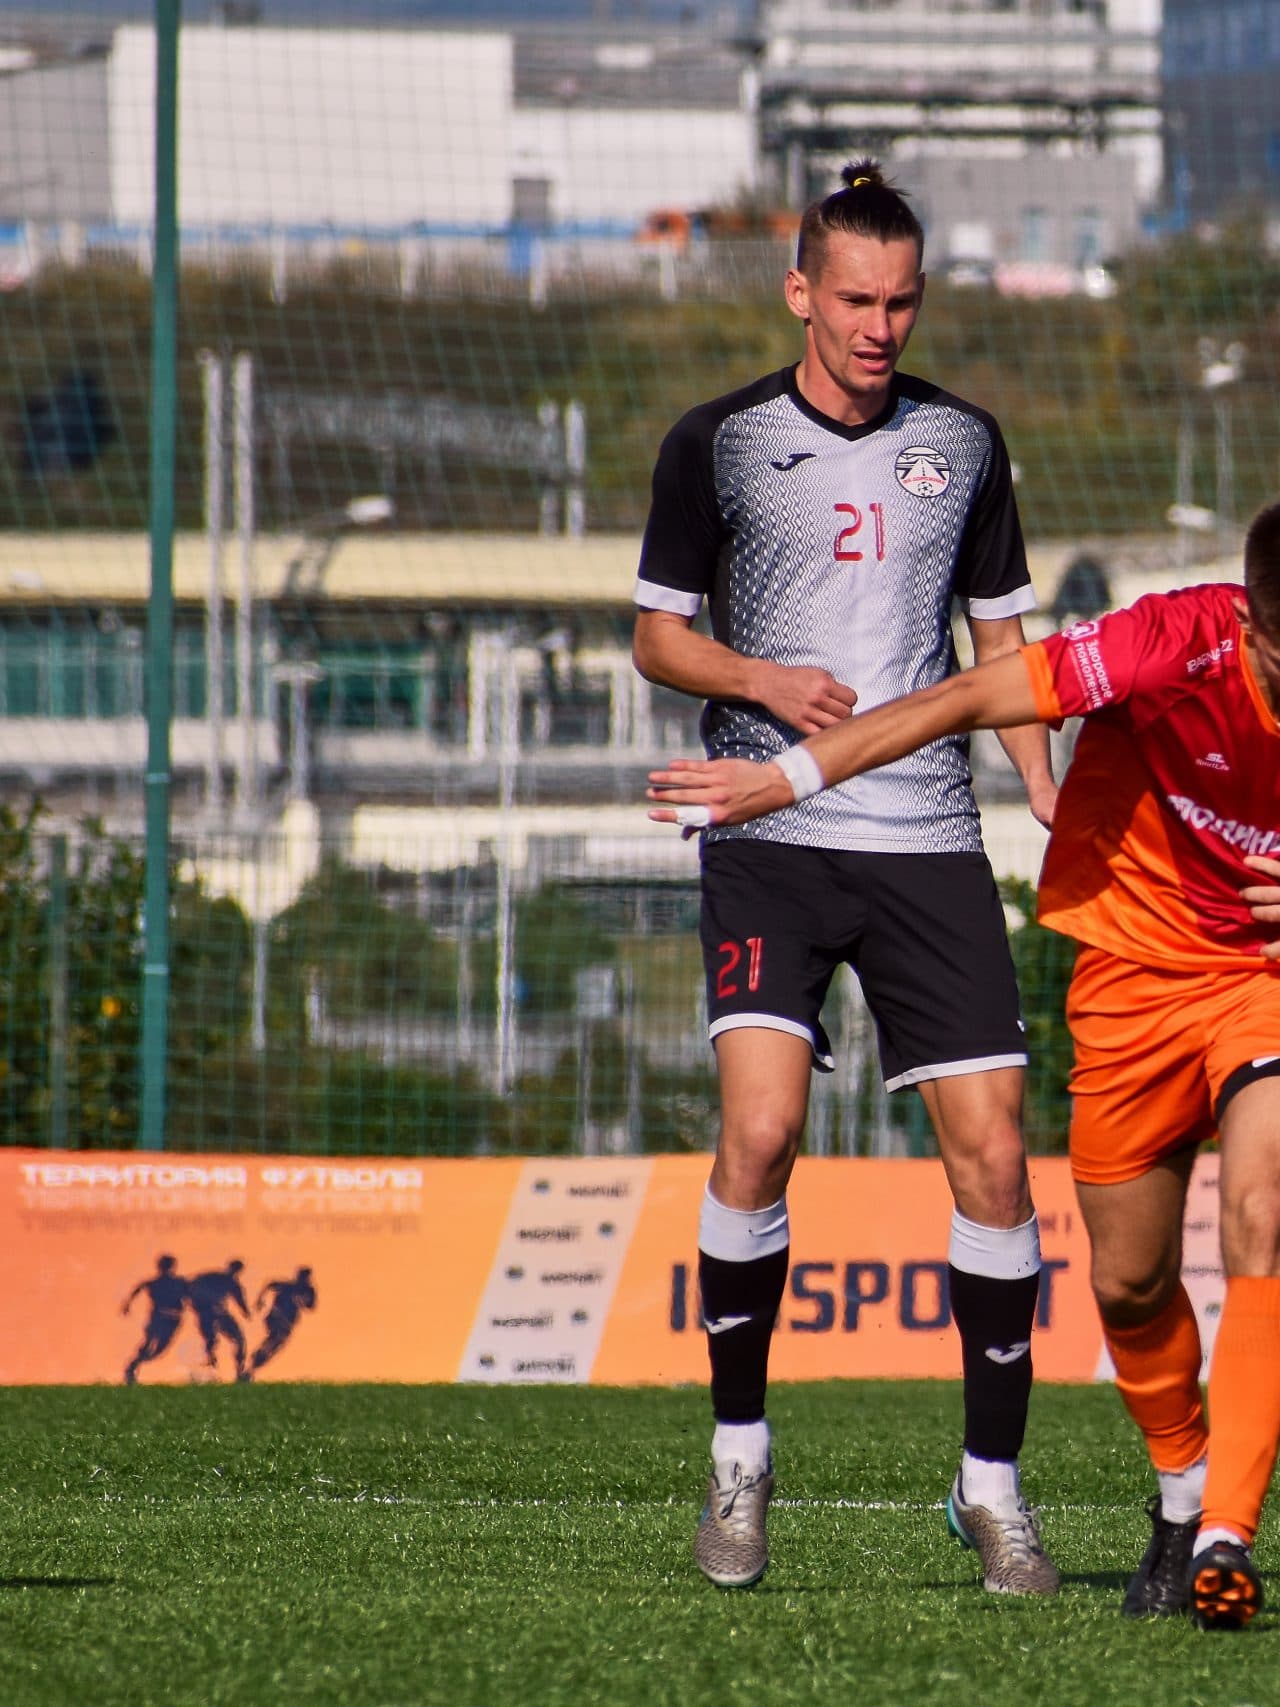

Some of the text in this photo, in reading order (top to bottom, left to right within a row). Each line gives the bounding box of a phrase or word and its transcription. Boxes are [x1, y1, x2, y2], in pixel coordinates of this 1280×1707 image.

[834, 502, 885, 561] 21
[1074, 642, 1103, 708] поколение
[1086, 640, 1113, 698] Здоровое
[717, 937, 763, 998] 21
[20, 1163, 247, 1187] ТЕРРИТОРИЯ
